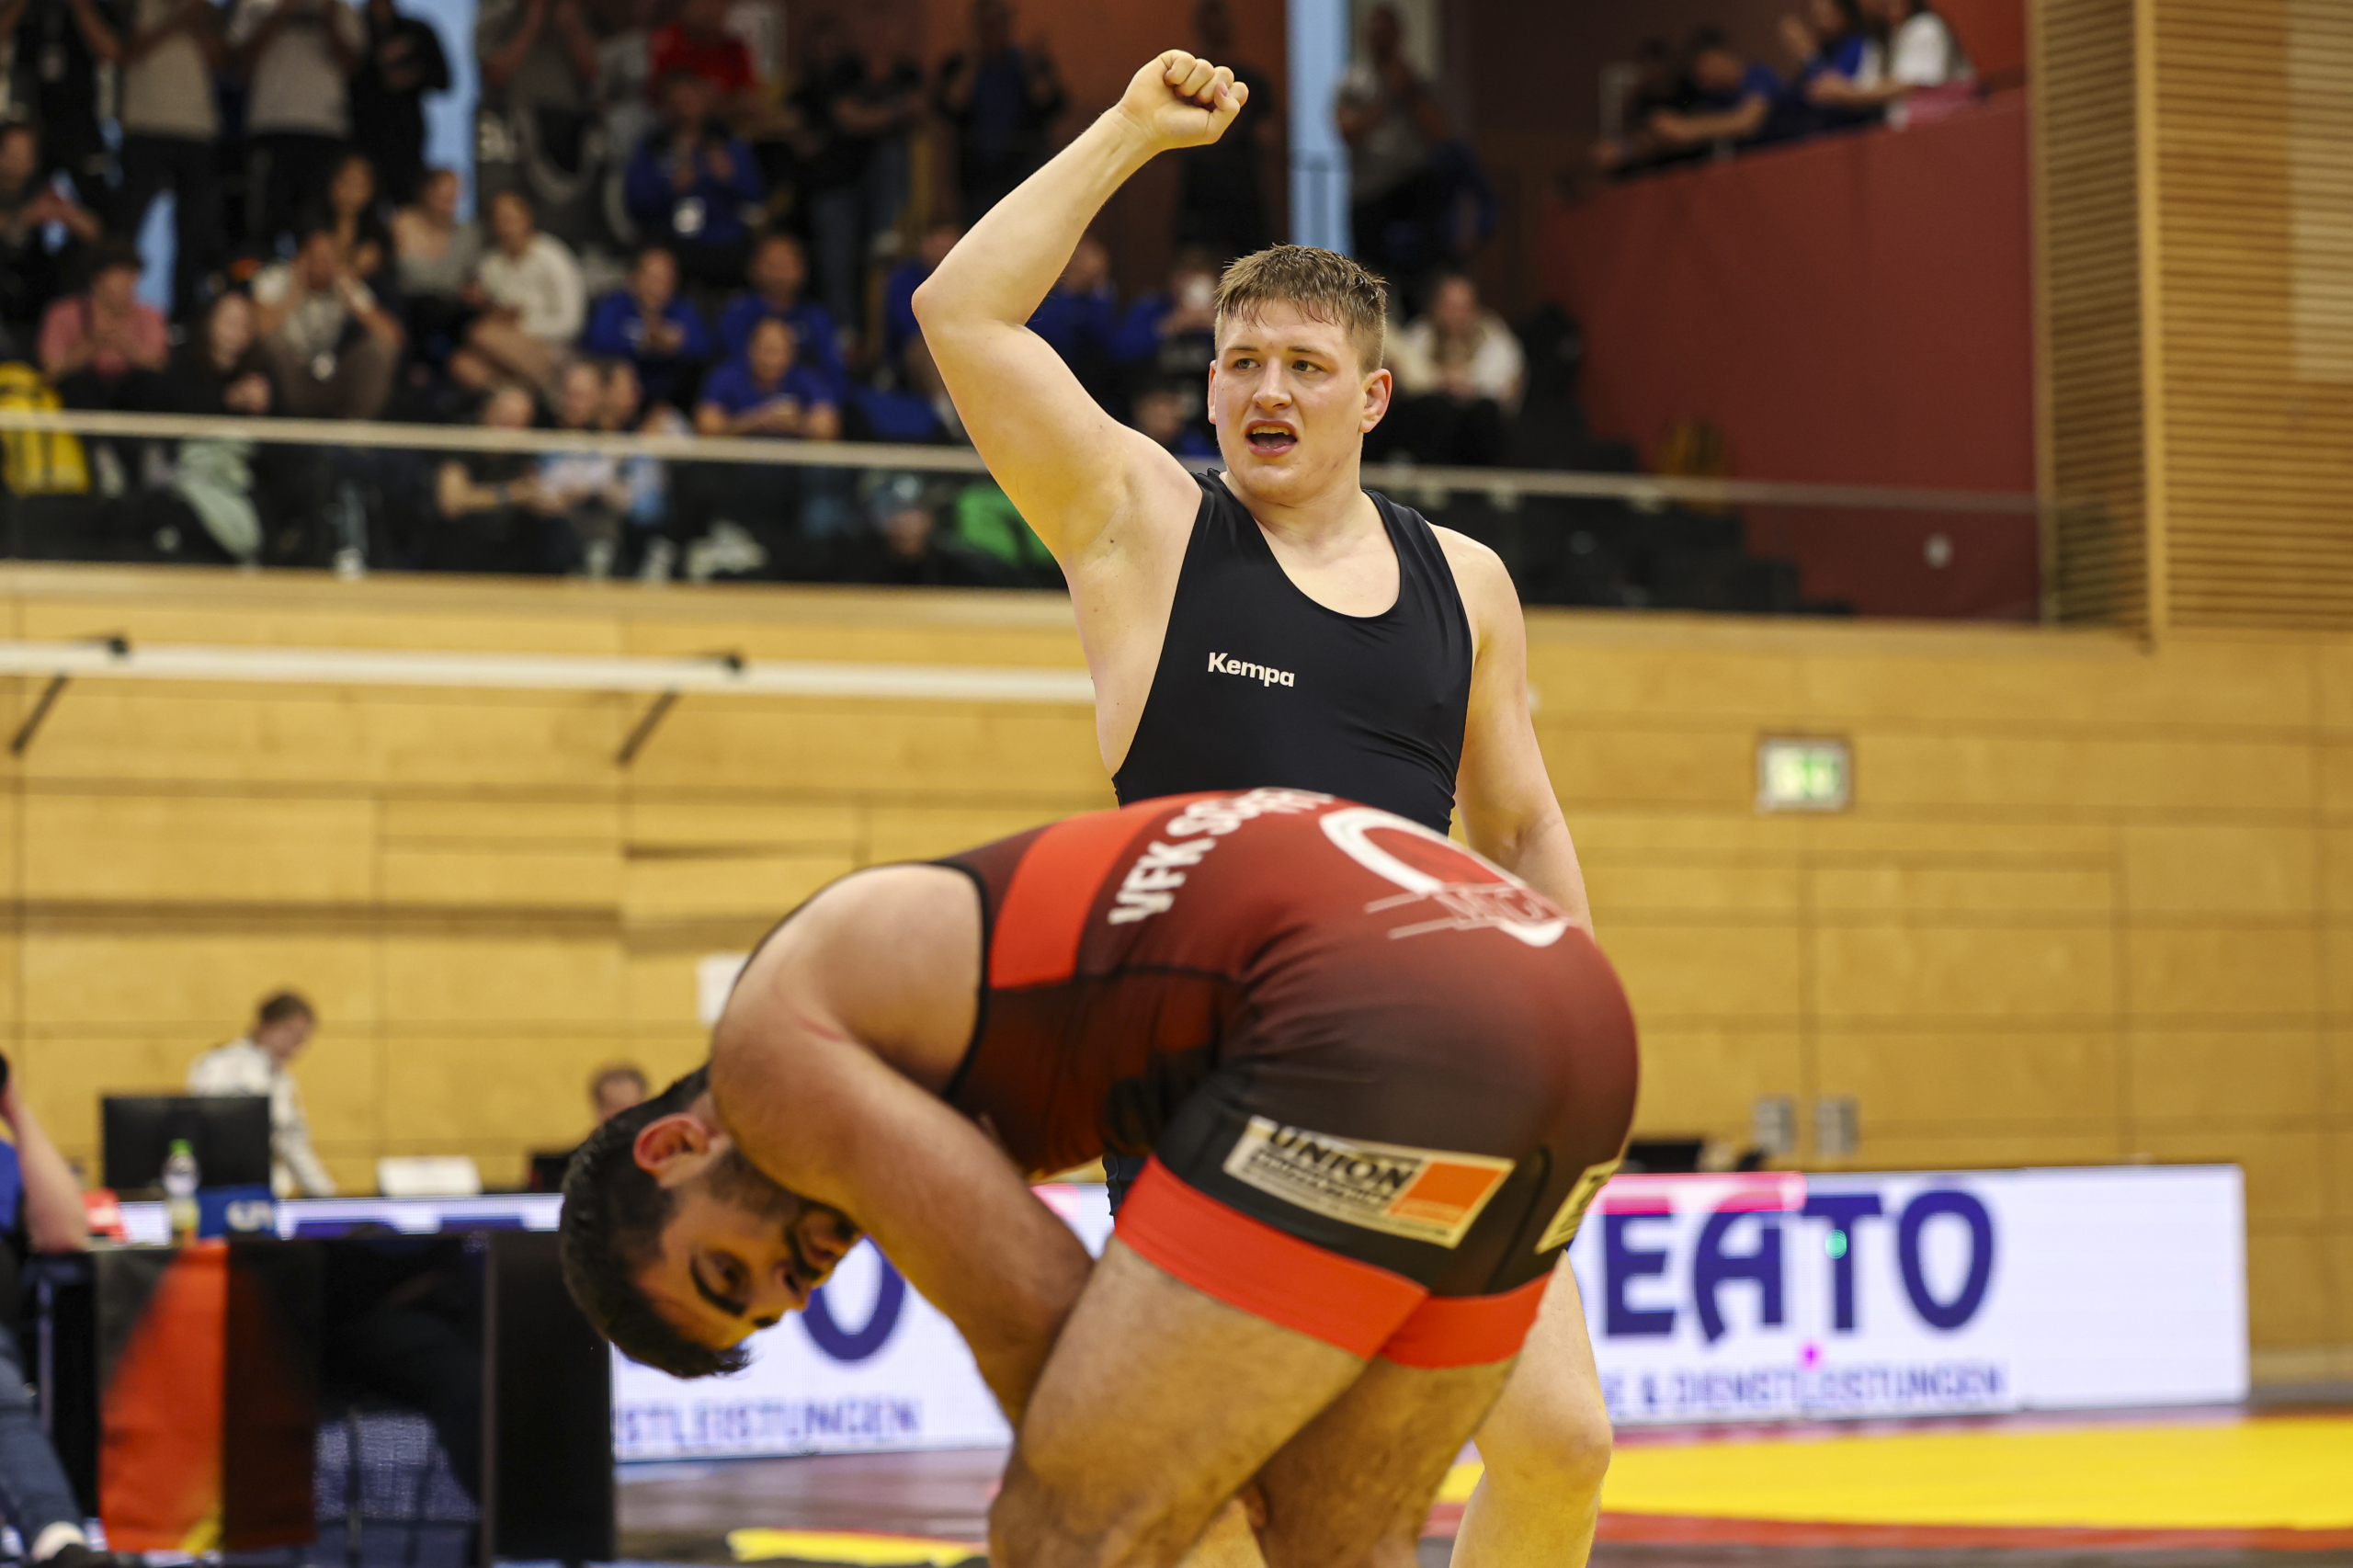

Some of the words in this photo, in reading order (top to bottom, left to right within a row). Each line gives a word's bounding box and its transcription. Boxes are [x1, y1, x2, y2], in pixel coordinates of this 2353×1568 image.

[1208, 652, 1295, 687] Kempa
[1108, 836, 1217, 925] VFK
[1268, 1127, 1415, 1189] UNION
[1603, 1188, 1995, 1345] EATO
